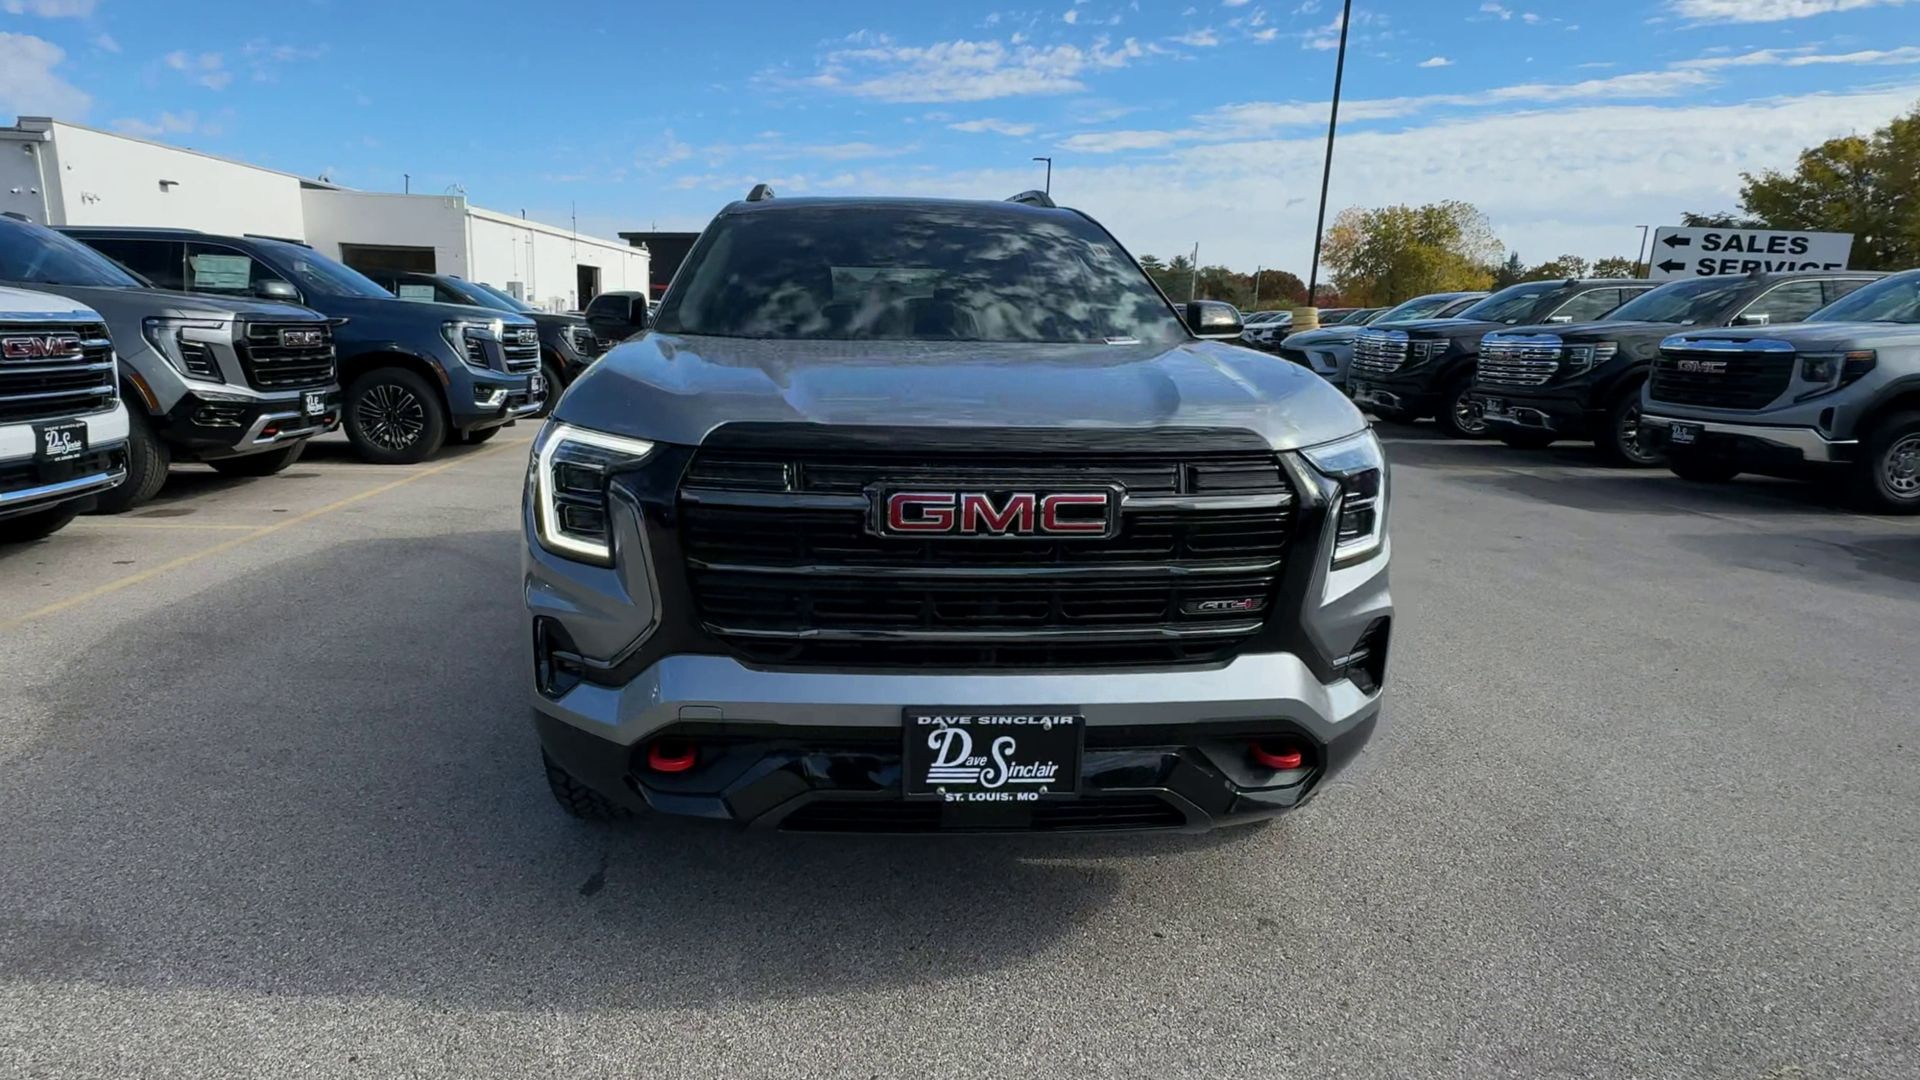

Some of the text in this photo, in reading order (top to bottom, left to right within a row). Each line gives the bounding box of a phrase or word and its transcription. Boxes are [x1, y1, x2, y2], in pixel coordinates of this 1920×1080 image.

[1701, 233, 1809, 255] SALES
[2, 337, 80, 358] GMC
[1678, 361, 1727, 373] GMC
[888, 492, 1107, 533] GMC
[917, 716, 1074, 725] DAVE SINCLAIR
[928, 728, 1058, 788] Dave Sinclair
[945, 792, 964, 801] ST.
[1017, 792, 1039, 801] MO
